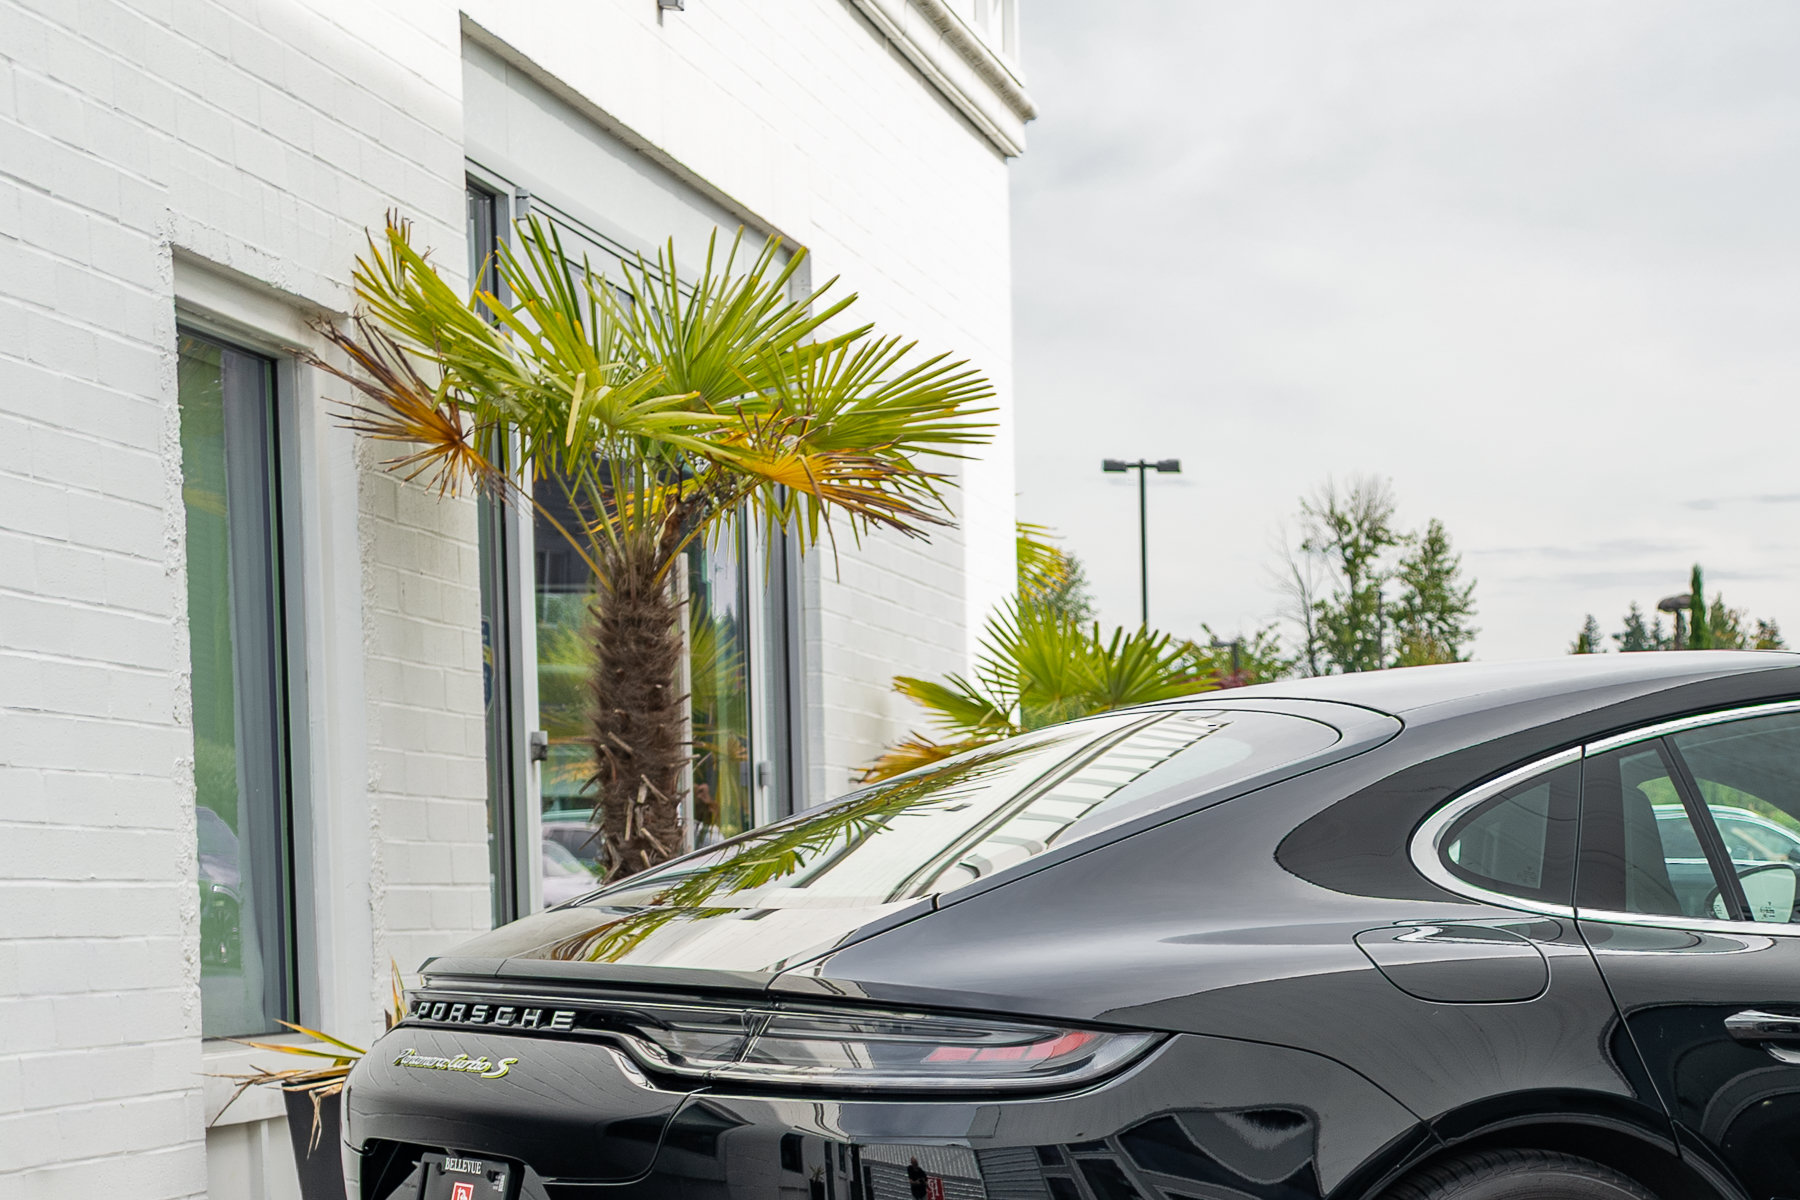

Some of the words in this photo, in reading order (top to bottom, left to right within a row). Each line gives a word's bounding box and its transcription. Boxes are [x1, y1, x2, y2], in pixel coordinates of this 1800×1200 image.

[417, 1002, 576, 1031] PORSCHE
[481, 1057, 518, 1078] S
[445, 1157, 482, 1174] BELLEVUE
